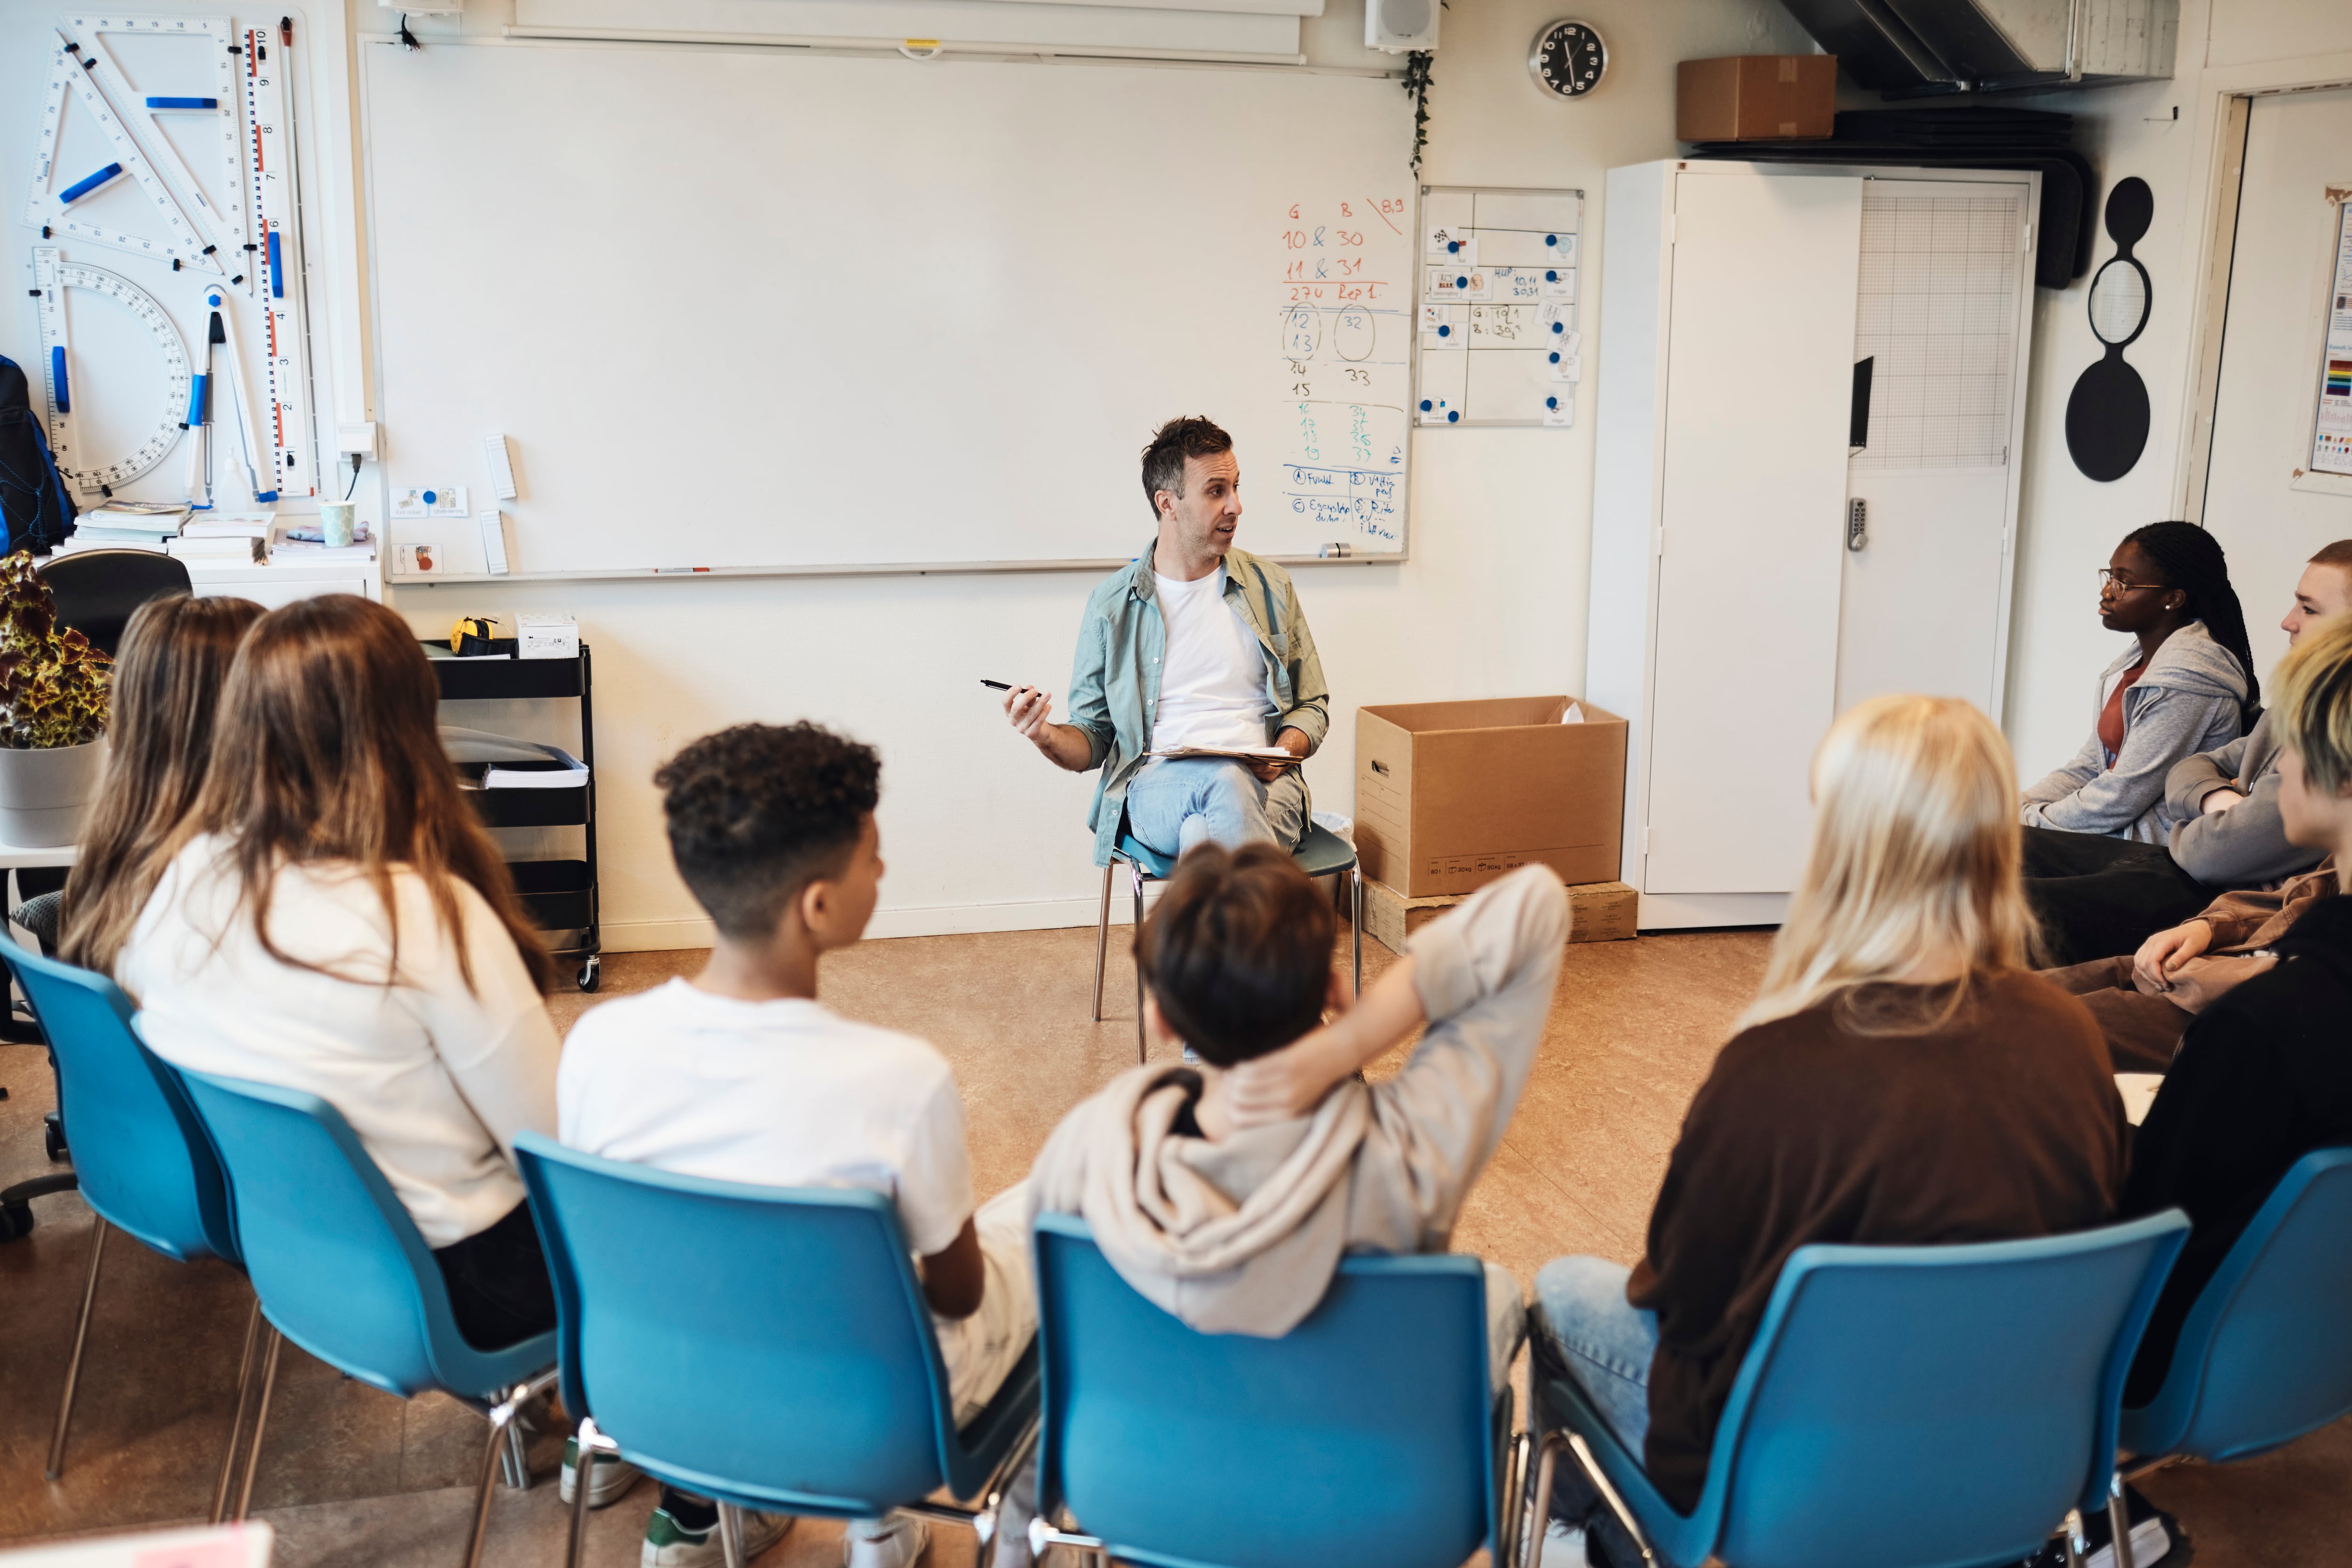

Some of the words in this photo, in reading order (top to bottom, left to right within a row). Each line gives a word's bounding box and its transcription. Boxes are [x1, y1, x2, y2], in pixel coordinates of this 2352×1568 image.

[256, 32, 266, 44] 10
[1544, 41, 1555, 50] 10
[1542, 69, 1551, 77] 8
[1585, 71, 1594, 80] 4
[1550, 80, 1560, 88] 7
[1562, 85, 1572, 94] 6
[1289, 204, 1299, 219] G
[1341, 203, 1352, 217] B
[1382, 199, 1404, 214] 8,9
[1282, 231, 1306, 249] 10
[1313, 226, 1326, 247] &
[1336, 231, 1363, 246] 30
[1287, 261, 1303, 279] 11
[1316, 259, 1328, 279] &
[1336, 258, 1361, 275] 31
[1292, 312, 1309, 328] 12
[1345, 317, 1361, 329] 32
[1293, 334, 1312, 351] 13
[1291, 363, 1306, 377] 14
[1345, 369, 1370, 386] 33
[1293, 383, 1311, 396] 15
[1299, 403, 1309, 414] 16
[1350, 406, 1365, 420] 34
[1301, 418, 1315, 429] 17
[1305, 446, 1319, 460] 19
[1352, 447, 1371, 462] 37
